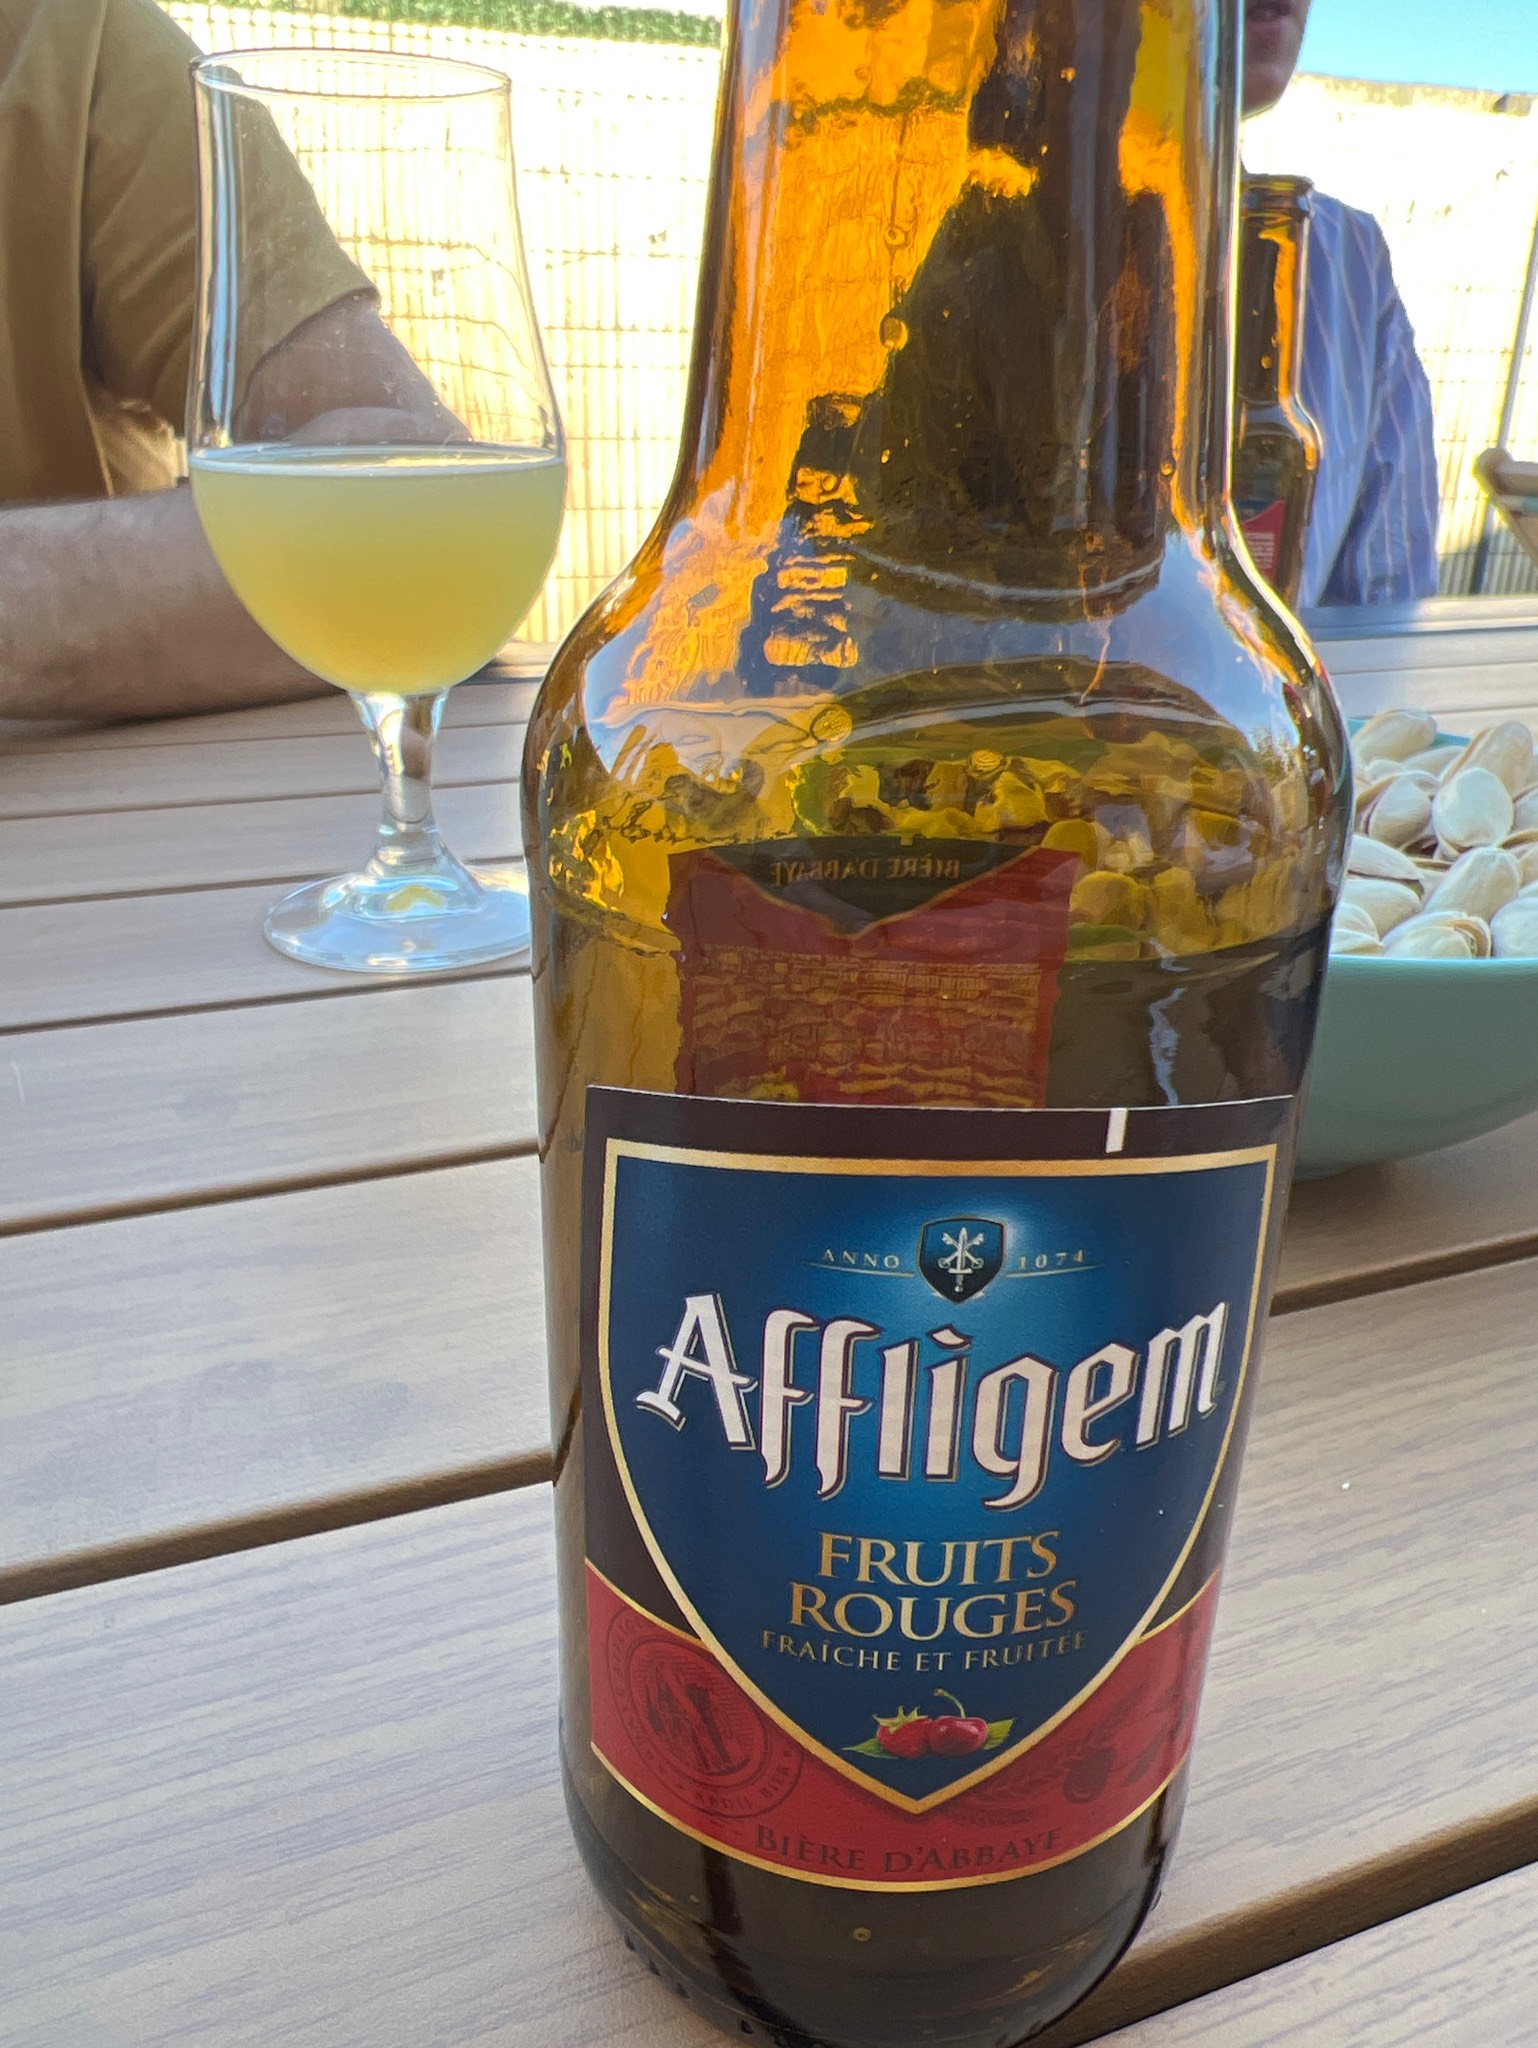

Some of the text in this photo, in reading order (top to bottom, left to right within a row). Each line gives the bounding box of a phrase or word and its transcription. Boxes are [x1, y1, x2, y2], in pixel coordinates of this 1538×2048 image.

[822, 1248, 1085, 1270] ANNO 1074
[636, 1291, 1230, 1511] Affligem
[817, 1530, 1061, 1588] FRUITS
[788, 1579, 1078, 1642] ROUGES
[762, 1630, 901, 1672] FRAÎCHE
[915, 1651, 953, 1672] ET
[755, 1825, 1064, 1873] BIÈRE D'ABBAYE
